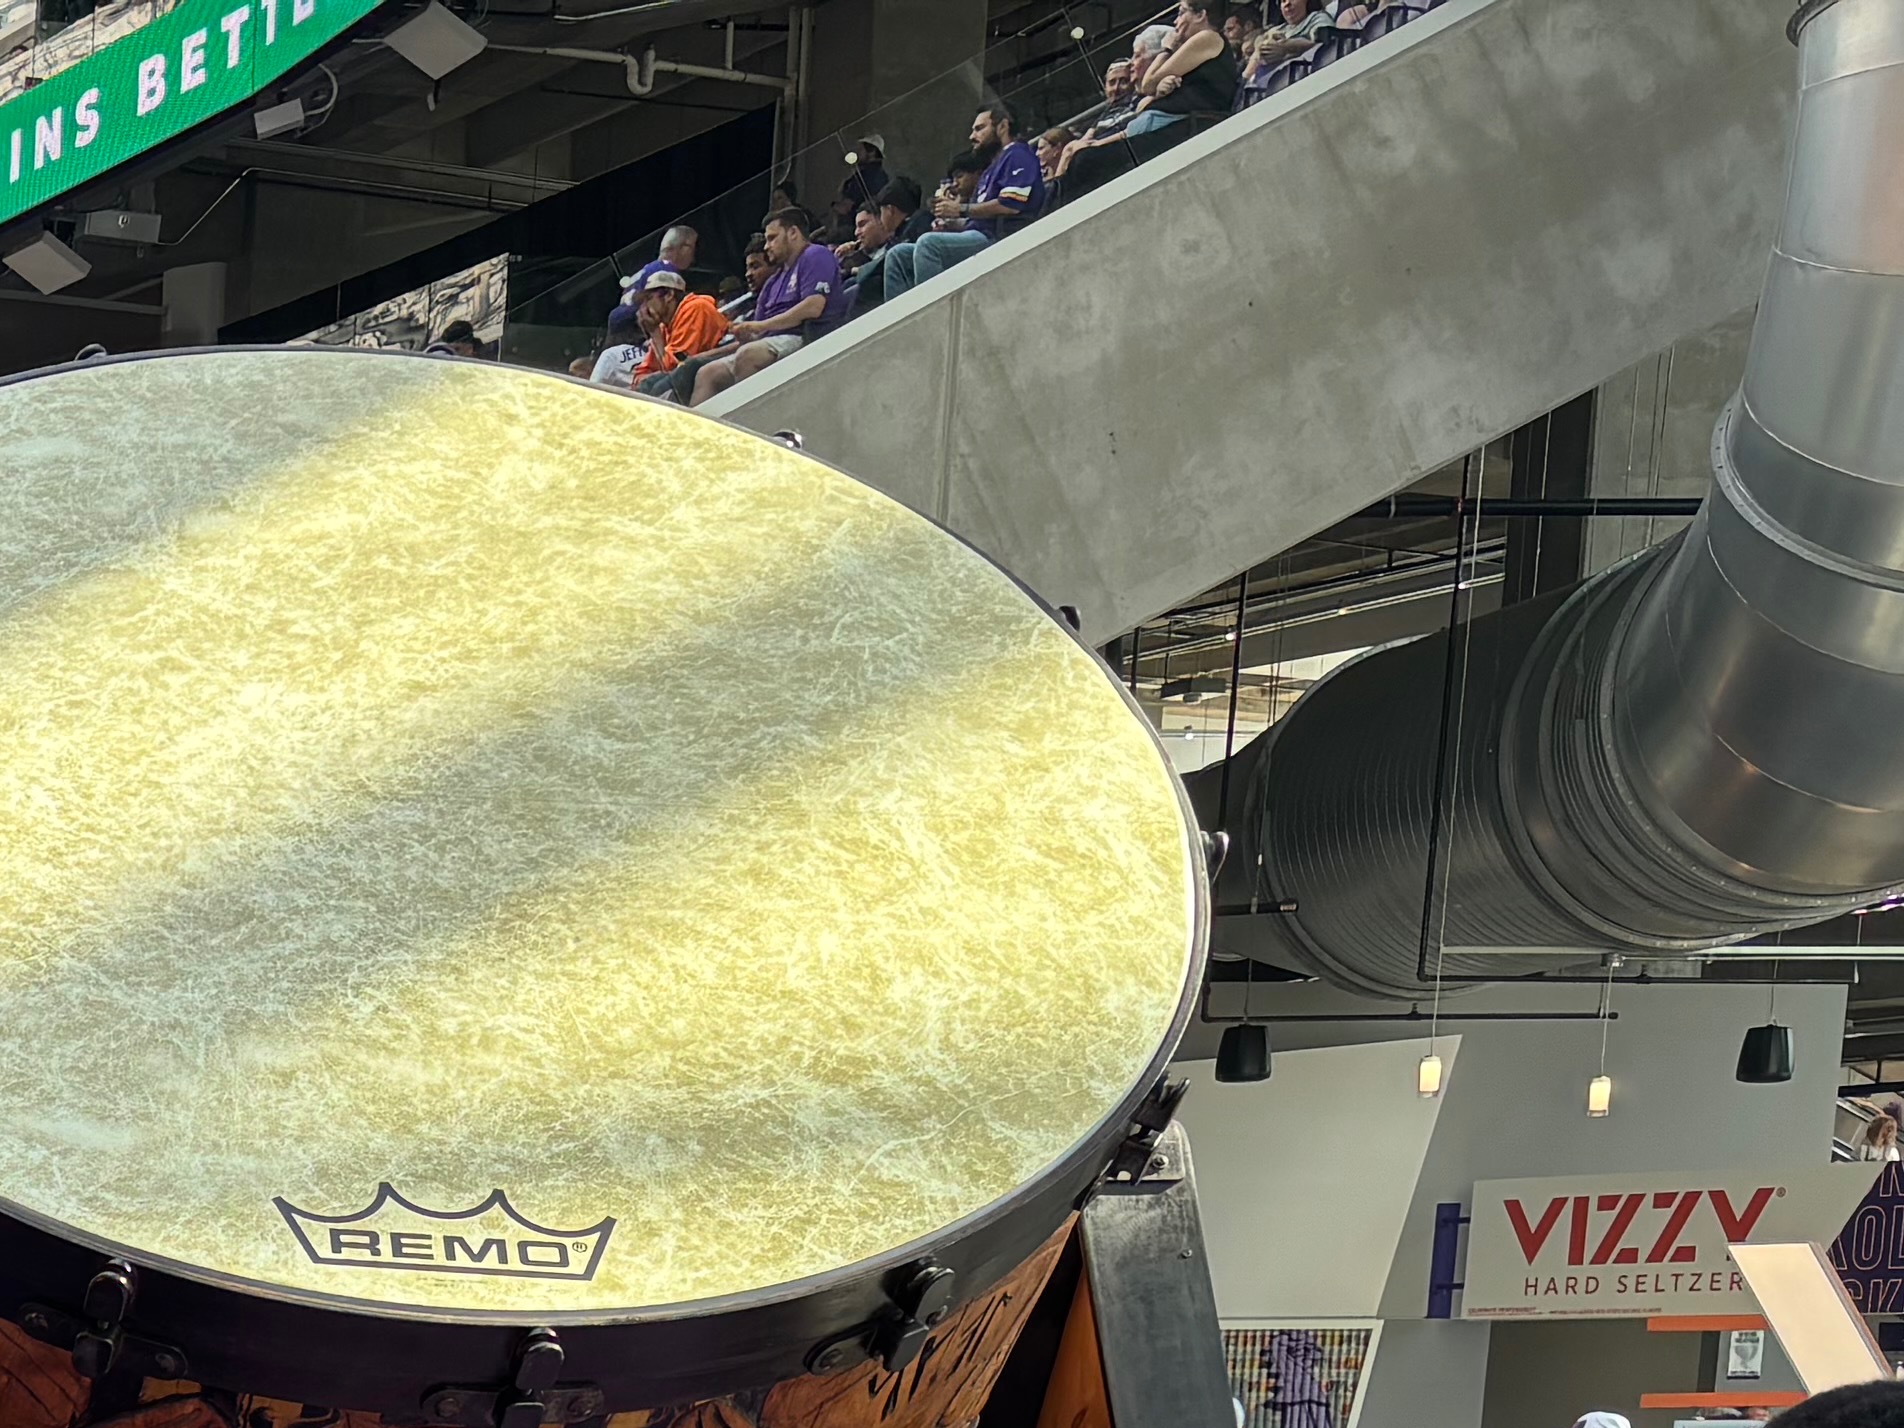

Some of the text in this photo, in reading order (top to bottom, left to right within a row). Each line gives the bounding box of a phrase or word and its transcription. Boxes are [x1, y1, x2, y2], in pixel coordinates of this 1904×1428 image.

[1502, 1186, 1776, 1267] VIZZY
[328, 1227, 570, 1268] REMO
[1524, 1271, 1744, 1297] HARD SELTZER
